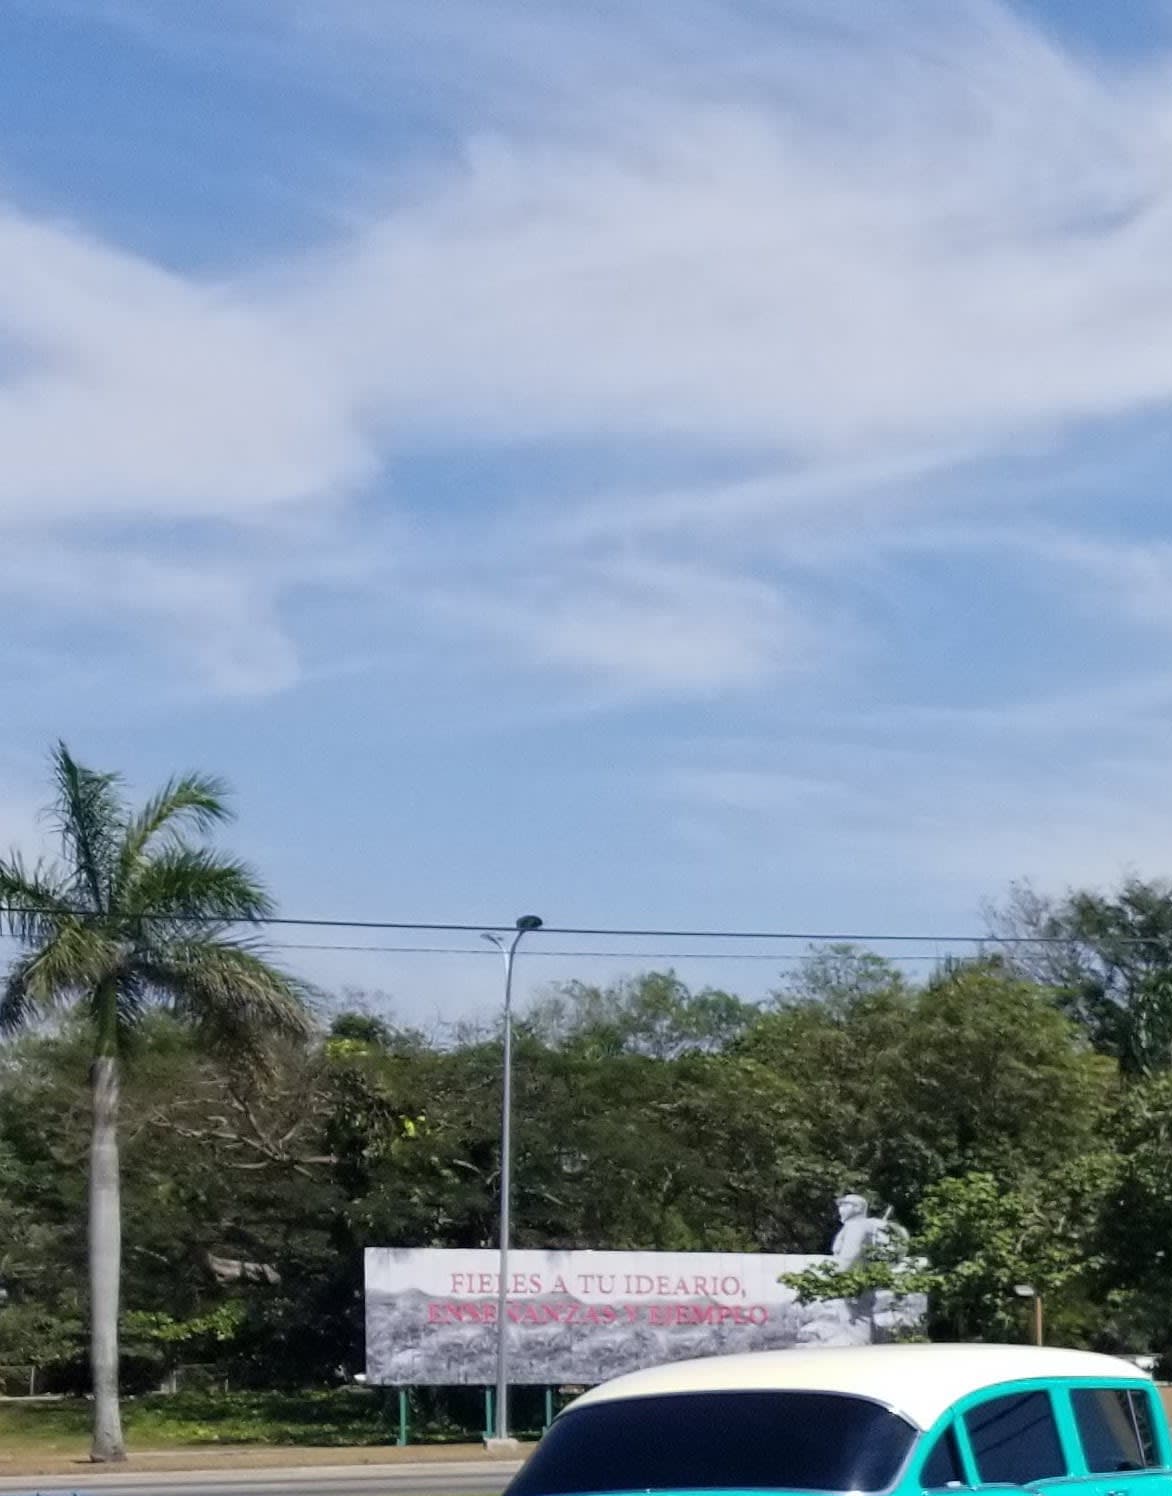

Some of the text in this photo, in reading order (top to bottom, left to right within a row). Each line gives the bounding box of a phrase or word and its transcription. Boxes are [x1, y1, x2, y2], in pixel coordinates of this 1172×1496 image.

[450, 1273, 746, 1297] FIELES A TU IDEARIO,
[623, 1303, 637, 1324] Y
[648, 1304, 768, 1326] EJEMPLO
